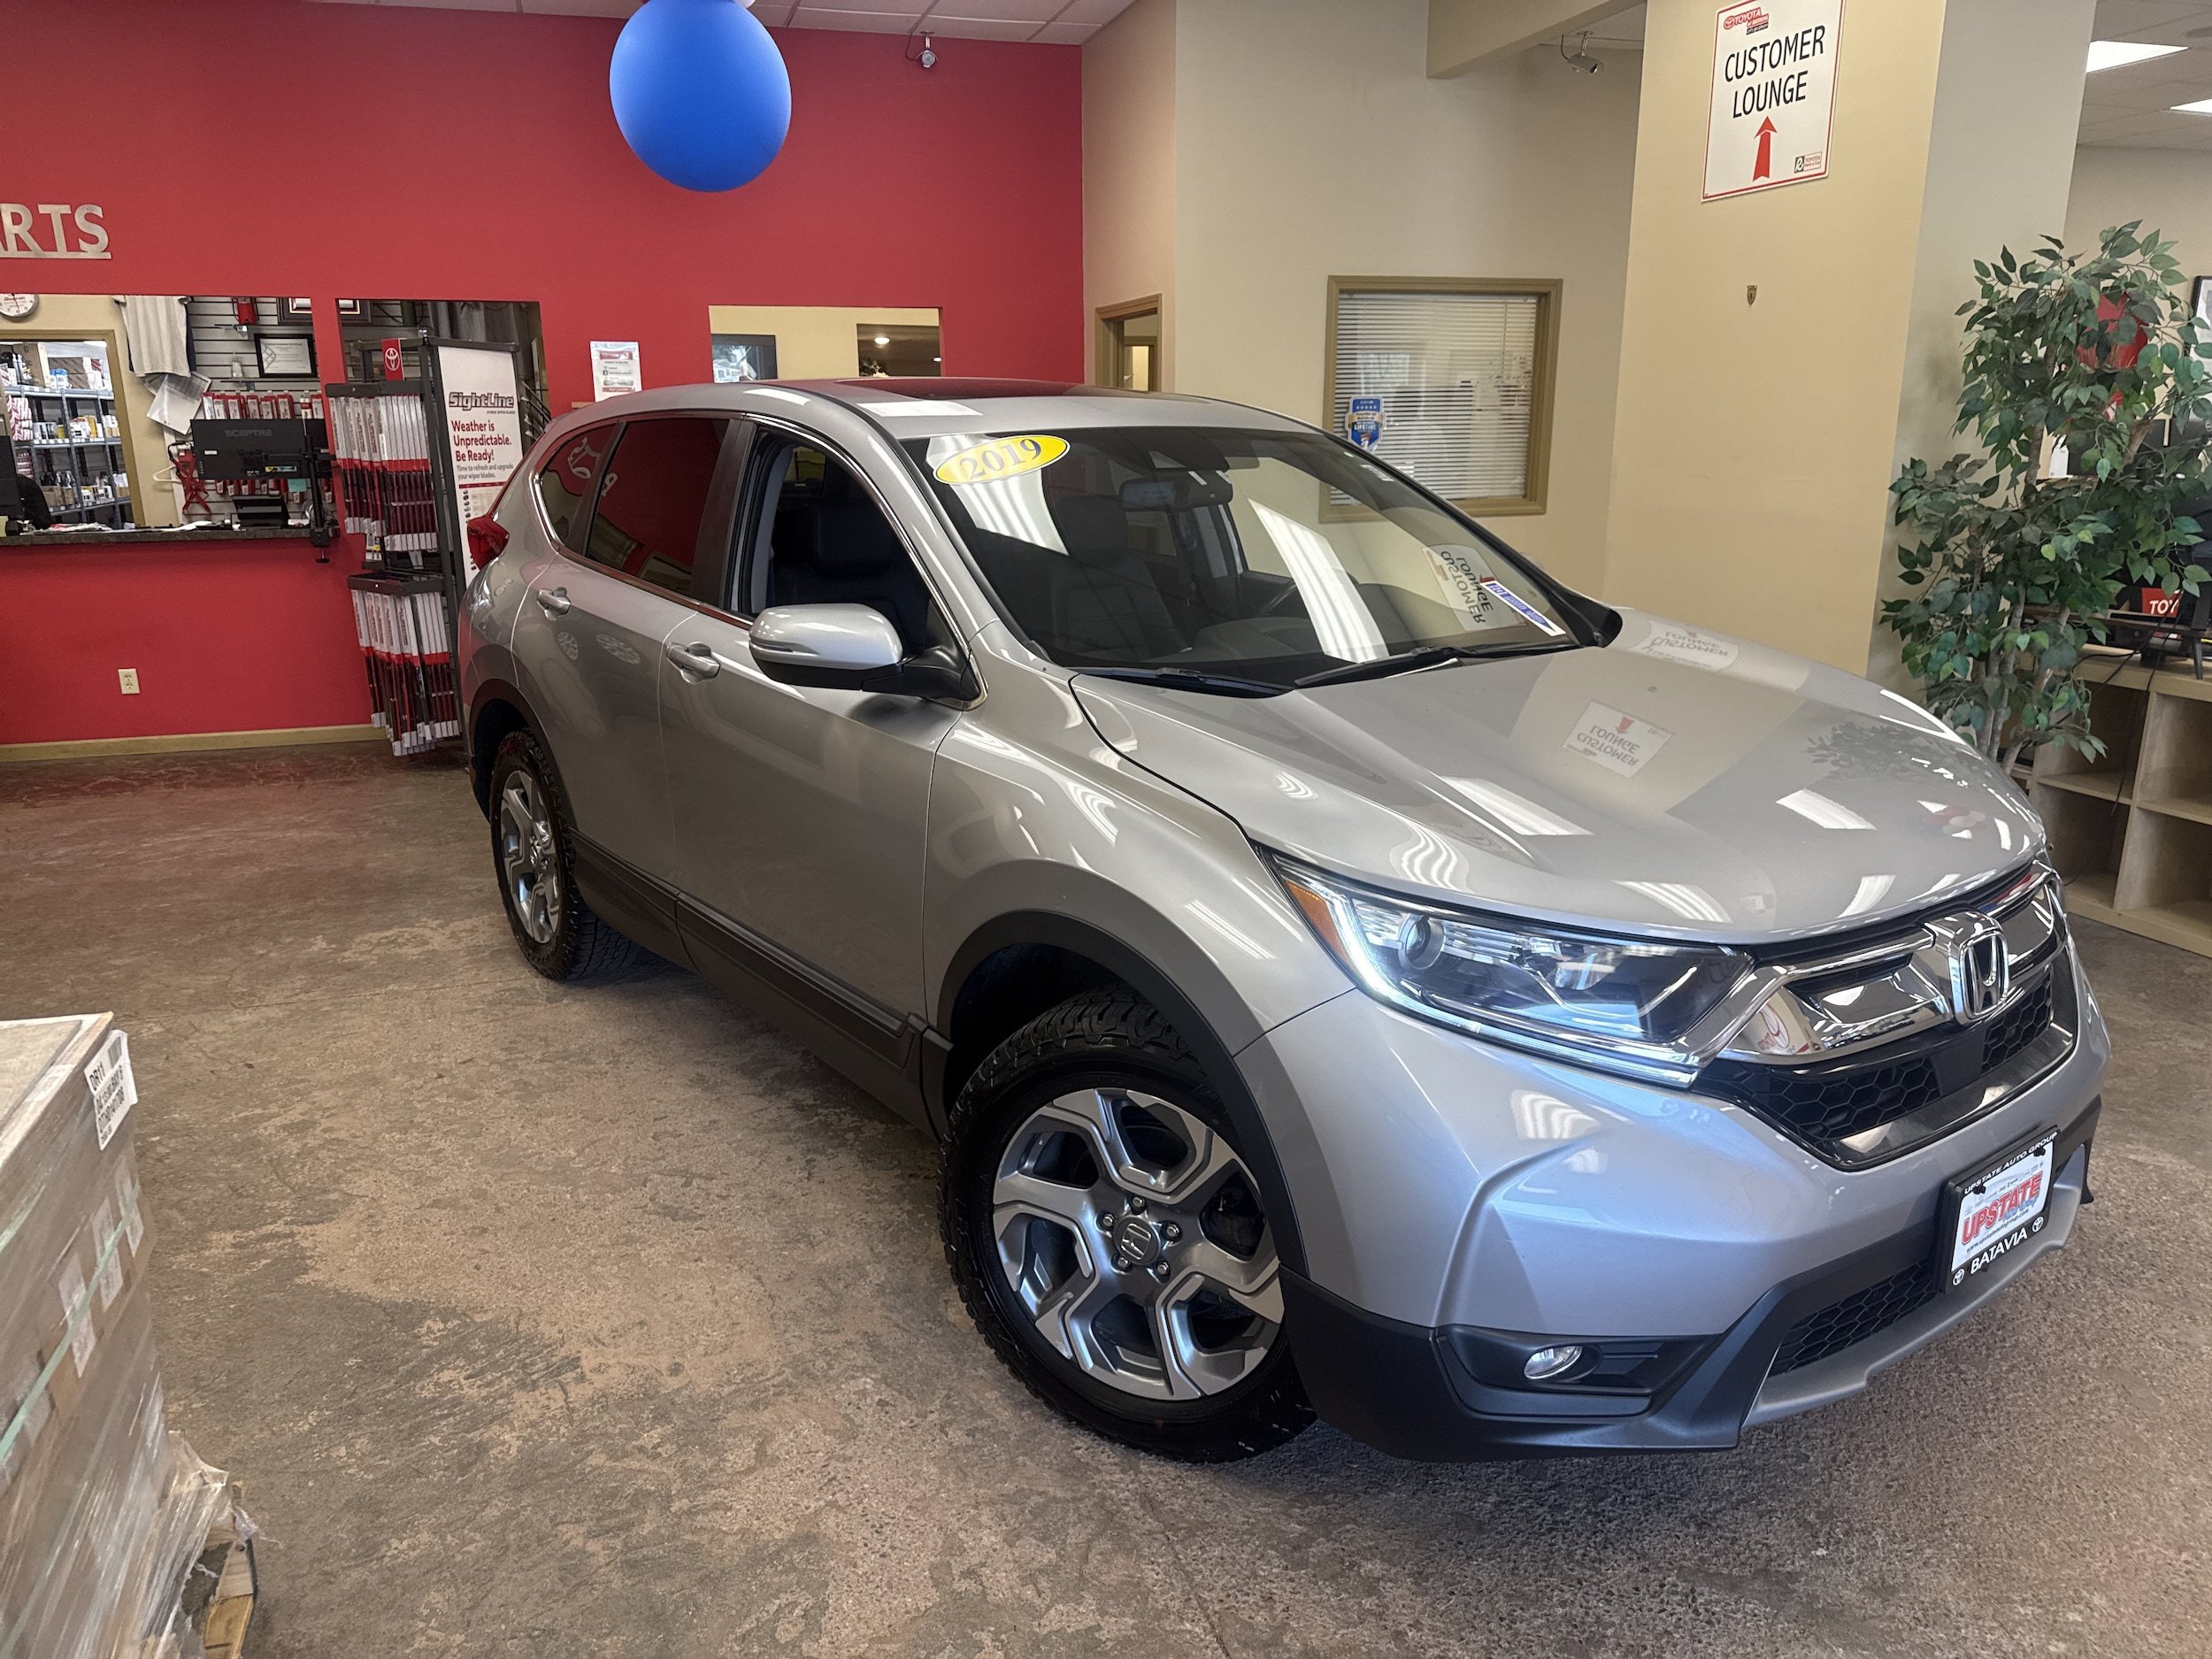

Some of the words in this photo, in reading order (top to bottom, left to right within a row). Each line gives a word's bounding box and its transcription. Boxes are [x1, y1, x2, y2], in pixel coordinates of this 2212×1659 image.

[1733, 6, 1761, 26] TOYOTA
[1724, 25, 1825, 82] CUSTOMER
[1732, 70, 1809, 119] LOUNGE
[0, 203, 110, 257] RTS
[449, 392, 514, 411] SightLine
[451, 419, 487, 433] Weather
[488, 420, 495, 432] is
[453, 434, 511, 449] Unpredictable.
[455, 450, 466, 462] Be
[467, 449, 495, 464] Ready!
[959, 438, 1042, 480] 2019
[1964, 1165, 2002, 1194] UPSTATE
[2002, 1151, 2027, 1170] AUTO
[2028, 1132, 2058, 1154] GROUP
[1961, 1170, 2043, 1245] UPSTATE
[1970, 1227, 2028, 1274] BATAVIA
